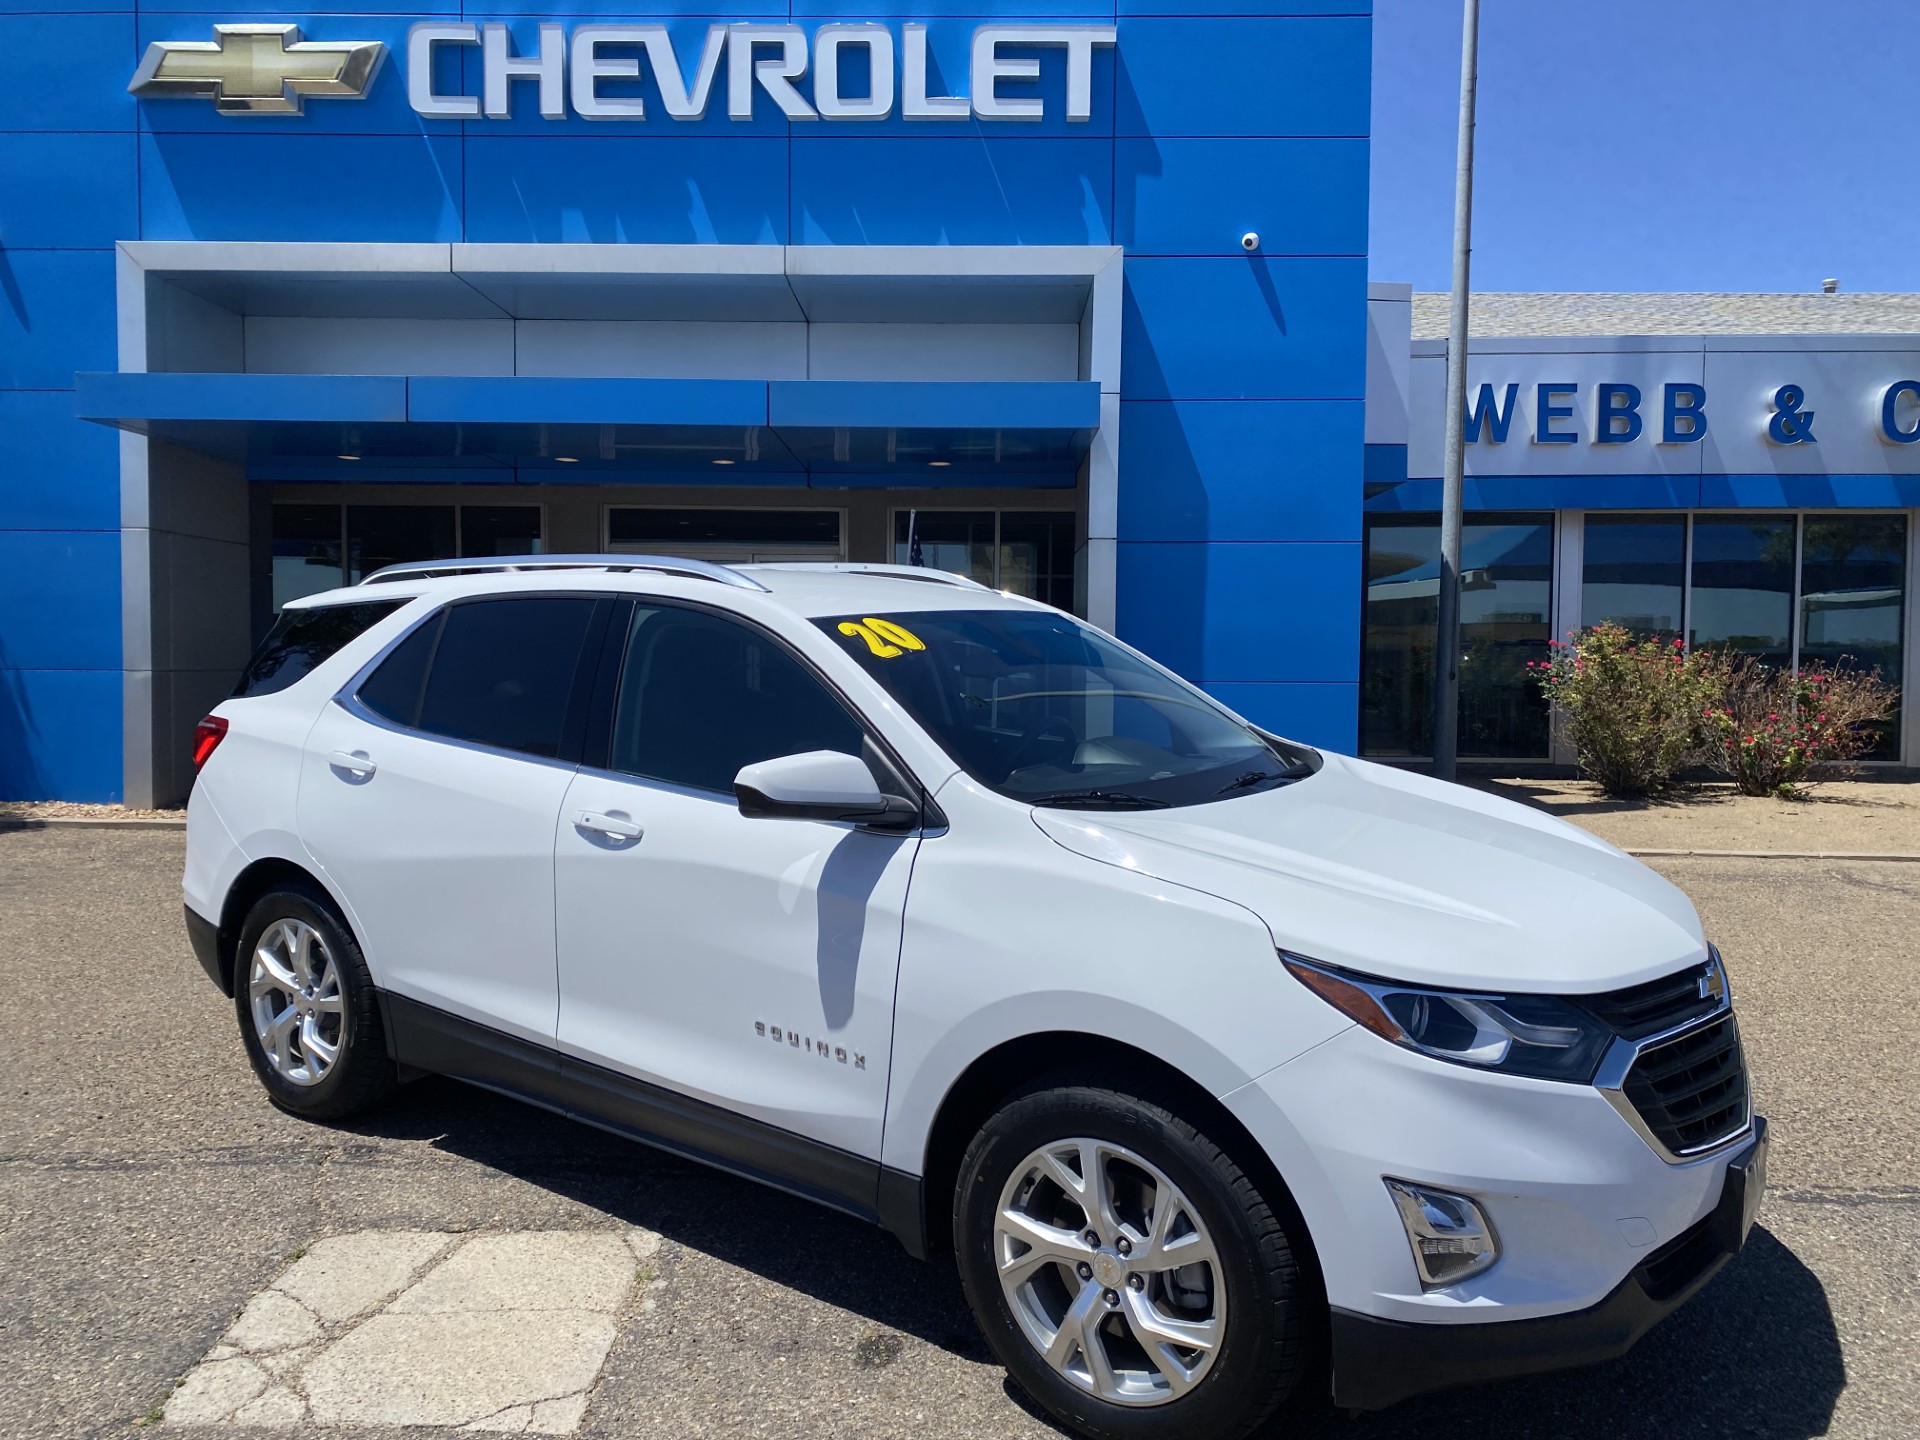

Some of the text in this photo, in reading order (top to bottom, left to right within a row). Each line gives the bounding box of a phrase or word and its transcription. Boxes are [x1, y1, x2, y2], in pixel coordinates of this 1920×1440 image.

[406, 22, 1117, 122] CHEVROLET
[1464, 382, 1708, 445] WEBB
[1765, 384, 1818, 445] &
[837, 617, 927, 659] 20
[754, 1020, 866, 1070] EQUINOX
[1004, 1099, 1158, 1132] Goodrich
